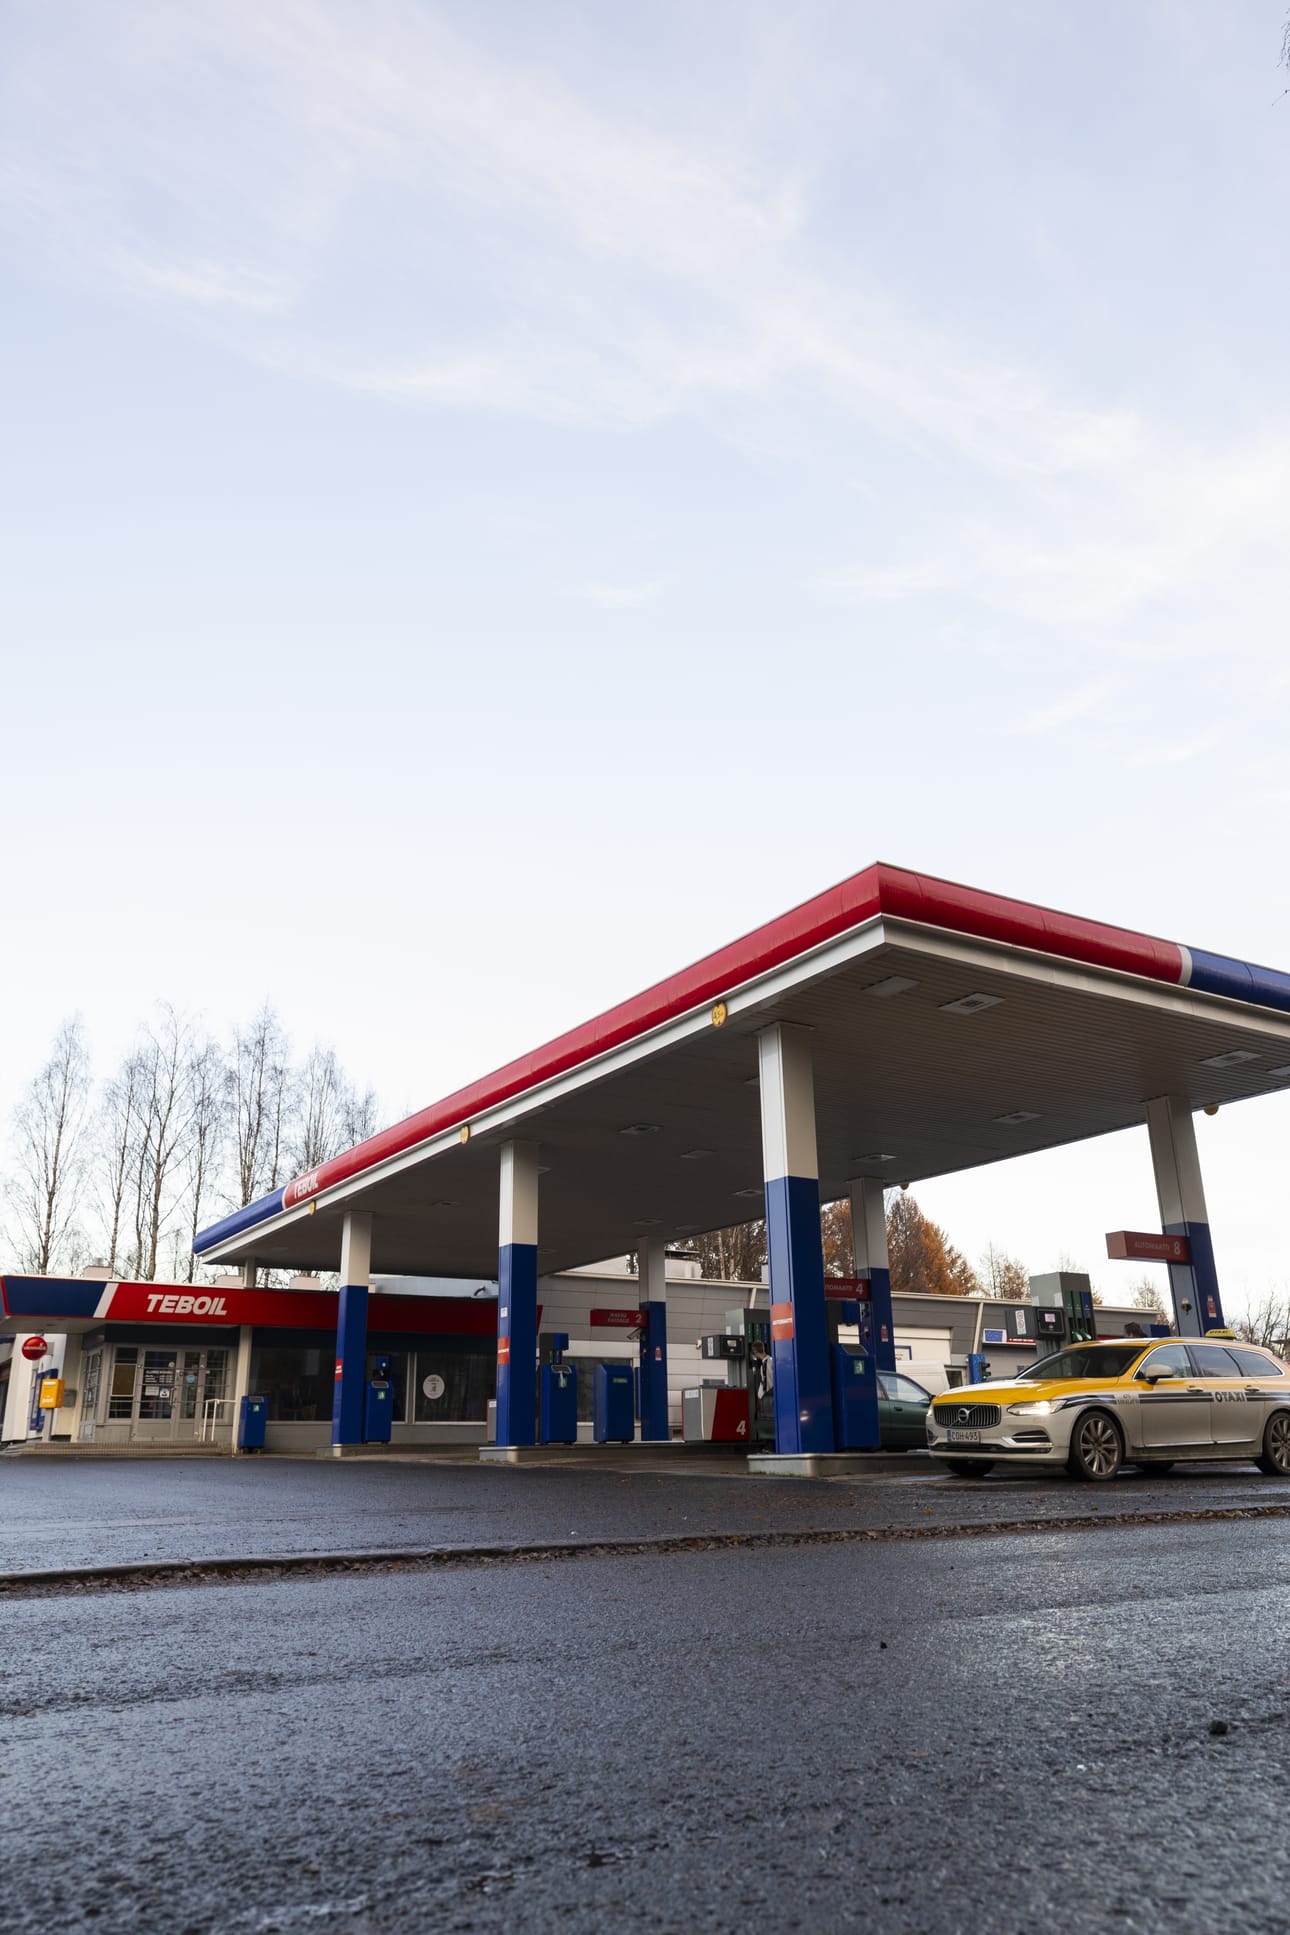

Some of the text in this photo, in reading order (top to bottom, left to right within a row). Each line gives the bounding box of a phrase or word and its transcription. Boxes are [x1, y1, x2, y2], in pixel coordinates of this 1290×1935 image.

[1174, 1241, 1181, 1256] 8
[855, 1283, 864, 1295] 4
[147, 1293, 228, 1316] TEBOIL
[635, 1313, 642, 1323] 2
[736, 1420, 746, 1435] 4
